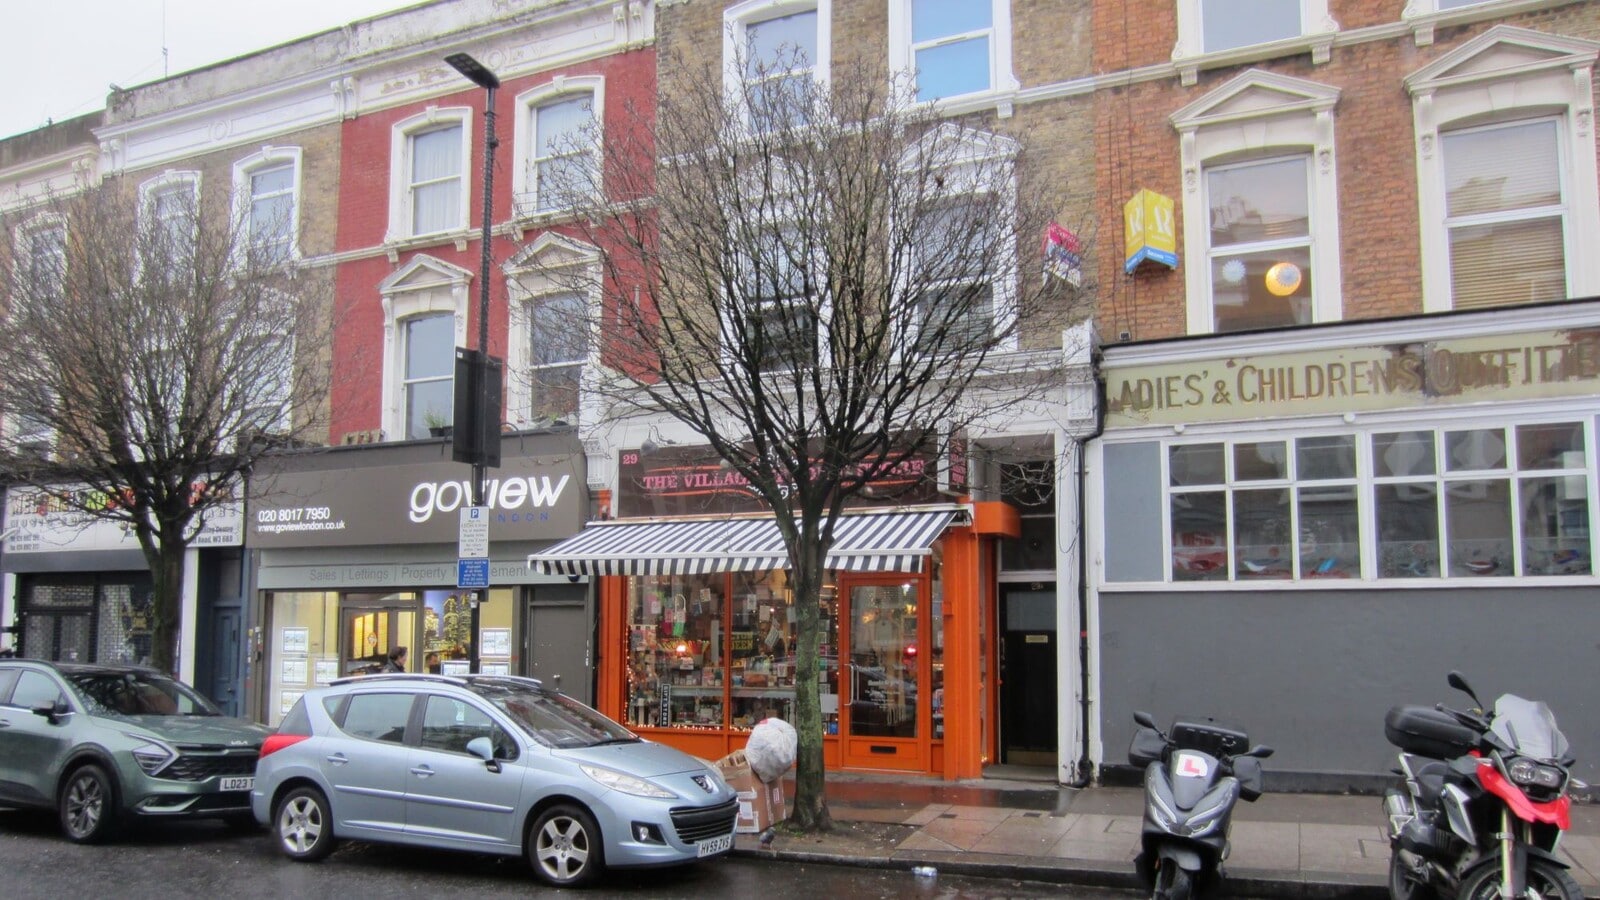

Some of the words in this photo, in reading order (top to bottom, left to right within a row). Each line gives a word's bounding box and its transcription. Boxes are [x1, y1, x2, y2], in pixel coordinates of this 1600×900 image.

[1106, 370, 1208, 412] ADIES'
[1211, 378, 1232, 405] &
[622, 453, 638, 465] 29
[643, 474, 678, 489] THE
[684, 471, 751, 488] VILLAG
[258, 509, 277, 522] 020
[278, 508, 303, 521] 8017
[305, 507, 330, 520] 7950
[258, 520, 345, 534] www.goviewlondon.co.uk
[309, 568, 337, 582] Sales
[348, 566, 389, 582] Lettings
[401, 566, 447, 581] Property
[1184, 759, 1200, 774] L
